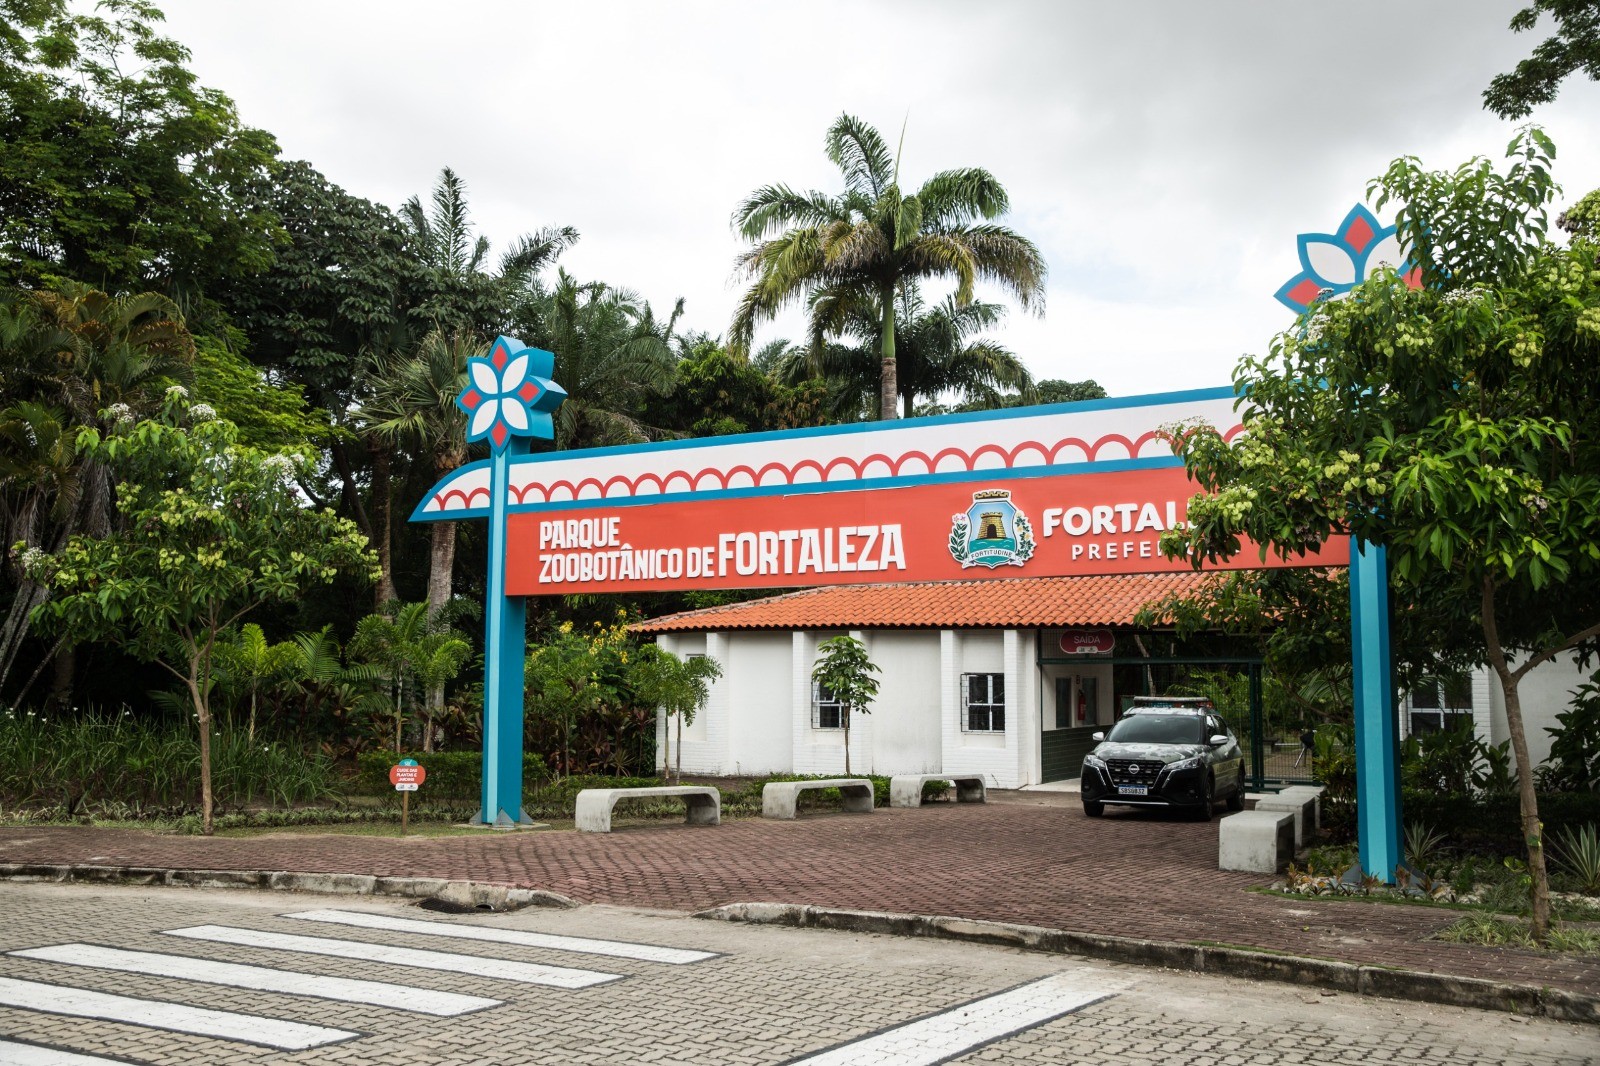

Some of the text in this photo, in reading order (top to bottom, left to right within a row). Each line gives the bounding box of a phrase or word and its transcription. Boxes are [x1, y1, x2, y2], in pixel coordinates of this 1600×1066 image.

[539, 516, 621, 550] PARQUE
[1042, 500, 1206, 538] FORTAL
[538, 523, 907, 583] ZOOBOTÂNICO DE FORTALEZA
[970, 549, 1013, 560] FORTITUDINE
[1073, 634, 1101, 644] SAÍDA
